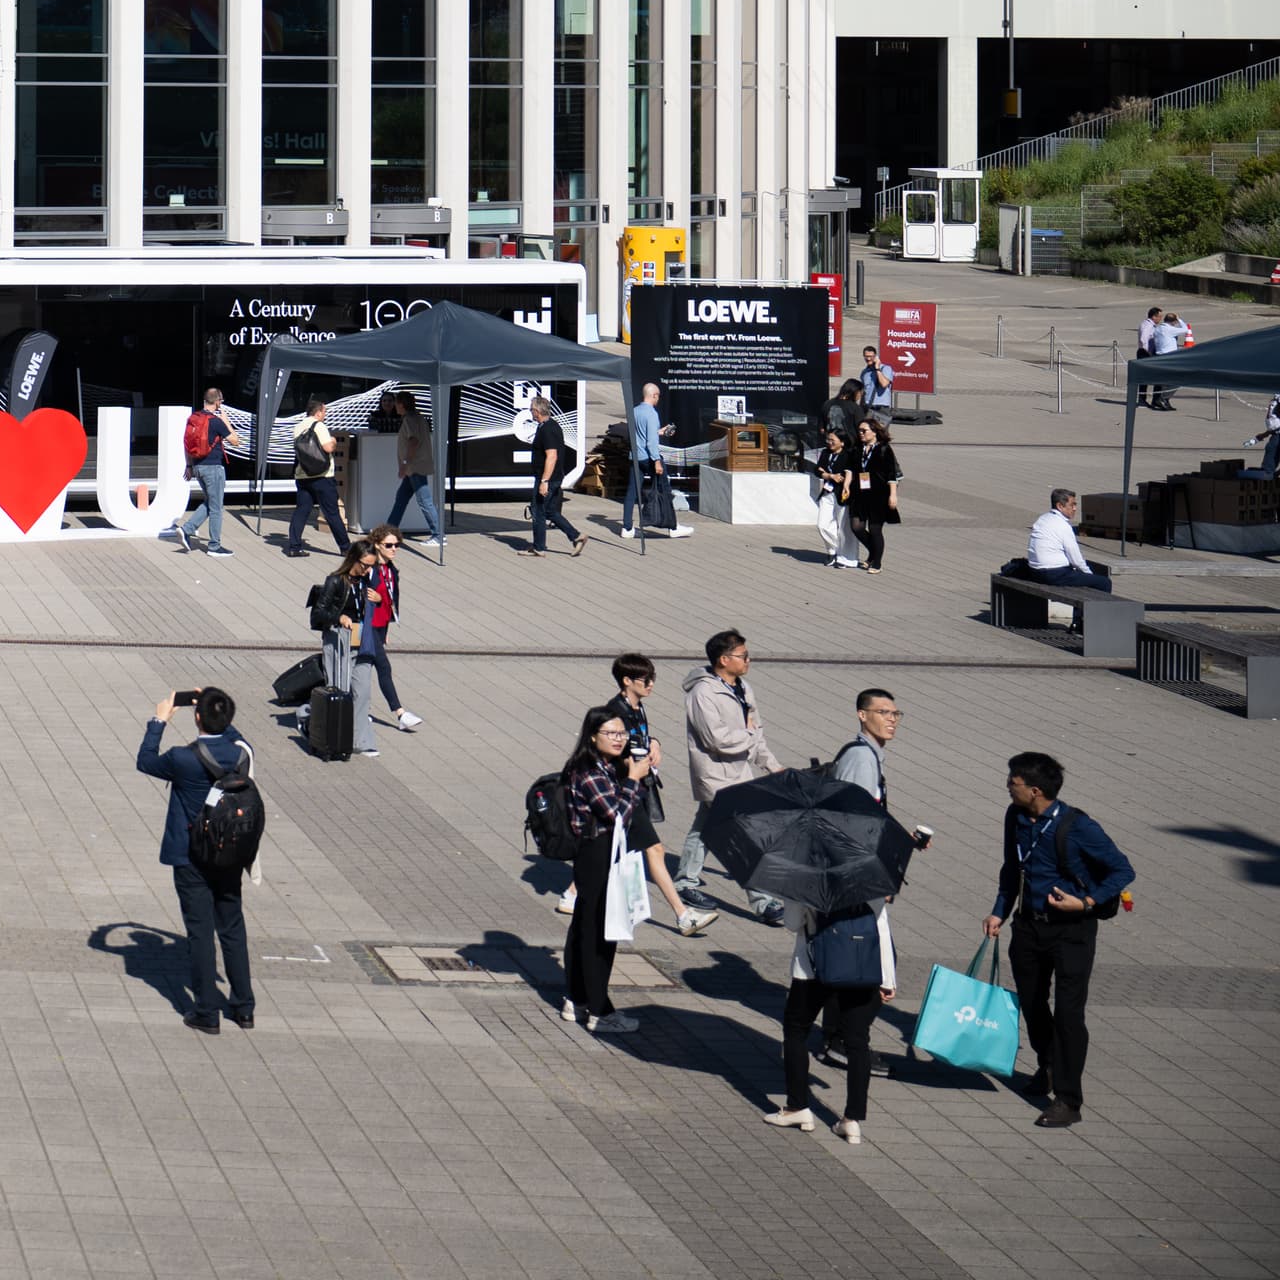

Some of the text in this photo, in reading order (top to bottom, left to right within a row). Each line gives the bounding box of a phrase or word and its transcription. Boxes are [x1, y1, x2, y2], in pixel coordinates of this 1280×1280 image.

[327, 213, 334, 224] B
[229, 298, 316, 321] A Century
[688, 299, 777, 323] LOEWE.
[229, 327, 248, 345] of
[693, 333, 708, 341] first
[710, 333, 725, 341] ever
[887, 329, 926, 339] Household
[887, 340, 927, 350] Appliances
[17, 351, 45, 400] LOEWE.
[95, 405, 190, 532] U
